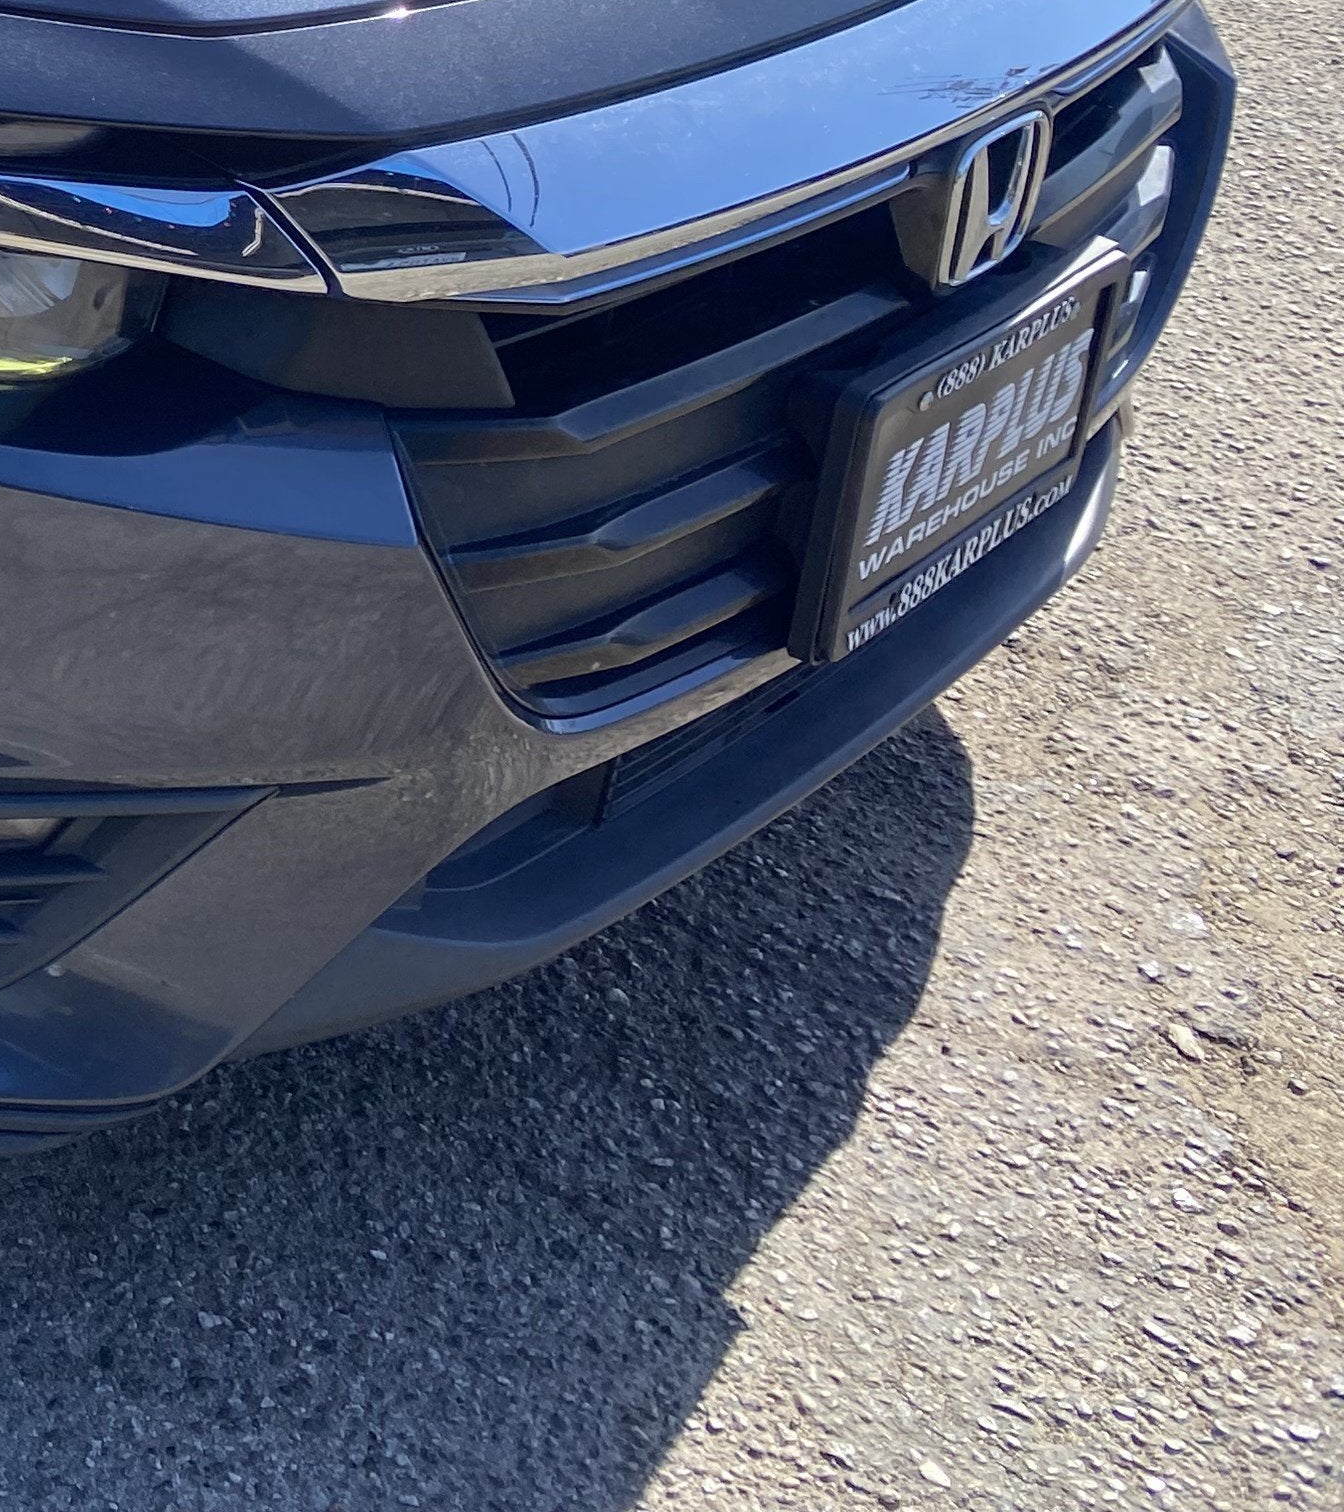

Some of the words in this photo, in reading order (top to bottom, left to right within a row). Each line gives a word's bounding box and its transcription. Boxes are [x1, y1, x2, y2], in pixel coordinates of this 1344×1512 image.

[937, 353, 986, 399] (888)
[988, 296, 1076, 371] KARPLUS
[862, 328, 1095, 548] KARPLUS
[859, 448, 1030, 581] WAREHOUSE
